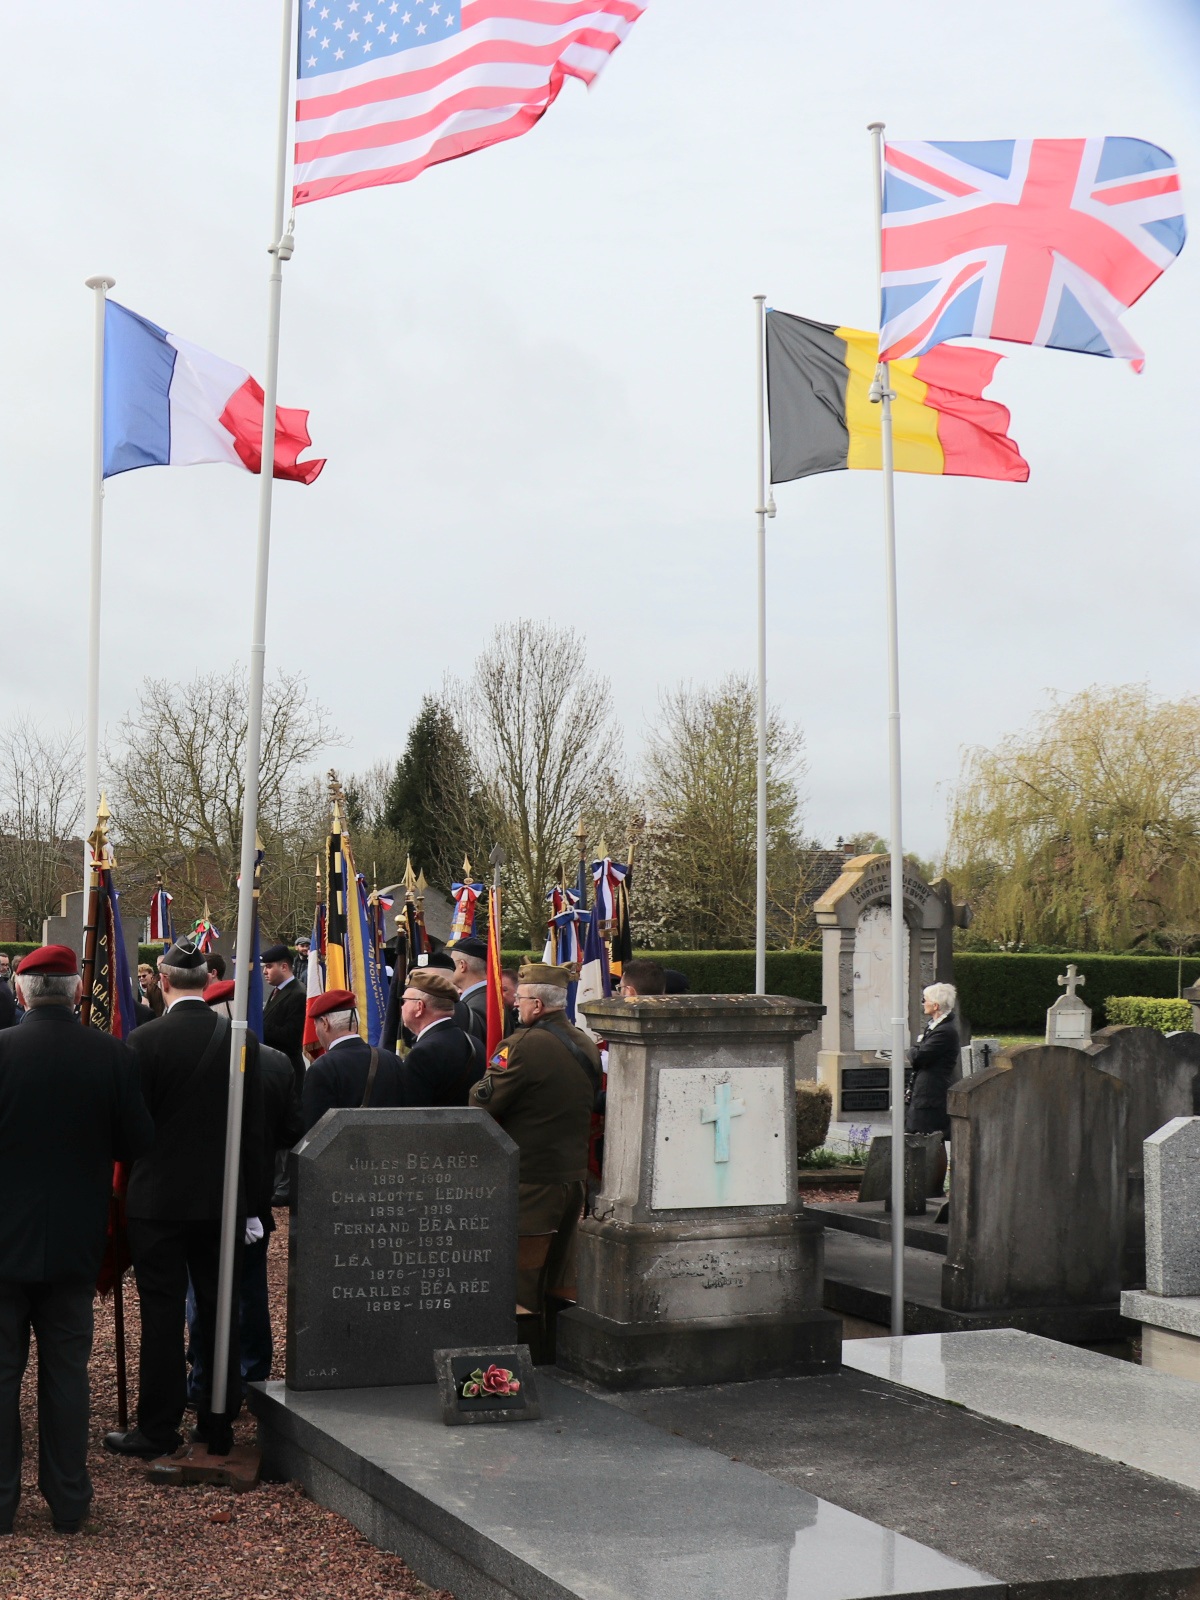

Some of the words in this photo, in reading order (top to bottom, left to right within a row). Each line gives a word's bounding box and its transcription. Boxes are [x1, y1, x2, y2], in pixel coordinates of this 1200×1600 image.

[350, 1157, 399, 1171] JULES
[331, 1190, 424, 1204] CHARLOTTE
[435, 1186, 497, 1201] LEDHUY
[333, 1222, 410, 1235] FERNAND
[334, 1253, 373, 1267] LÉA
[391, 1248, 492, 1266] DELECOURT
[332, 1284, 411, 1299] CHARLES
